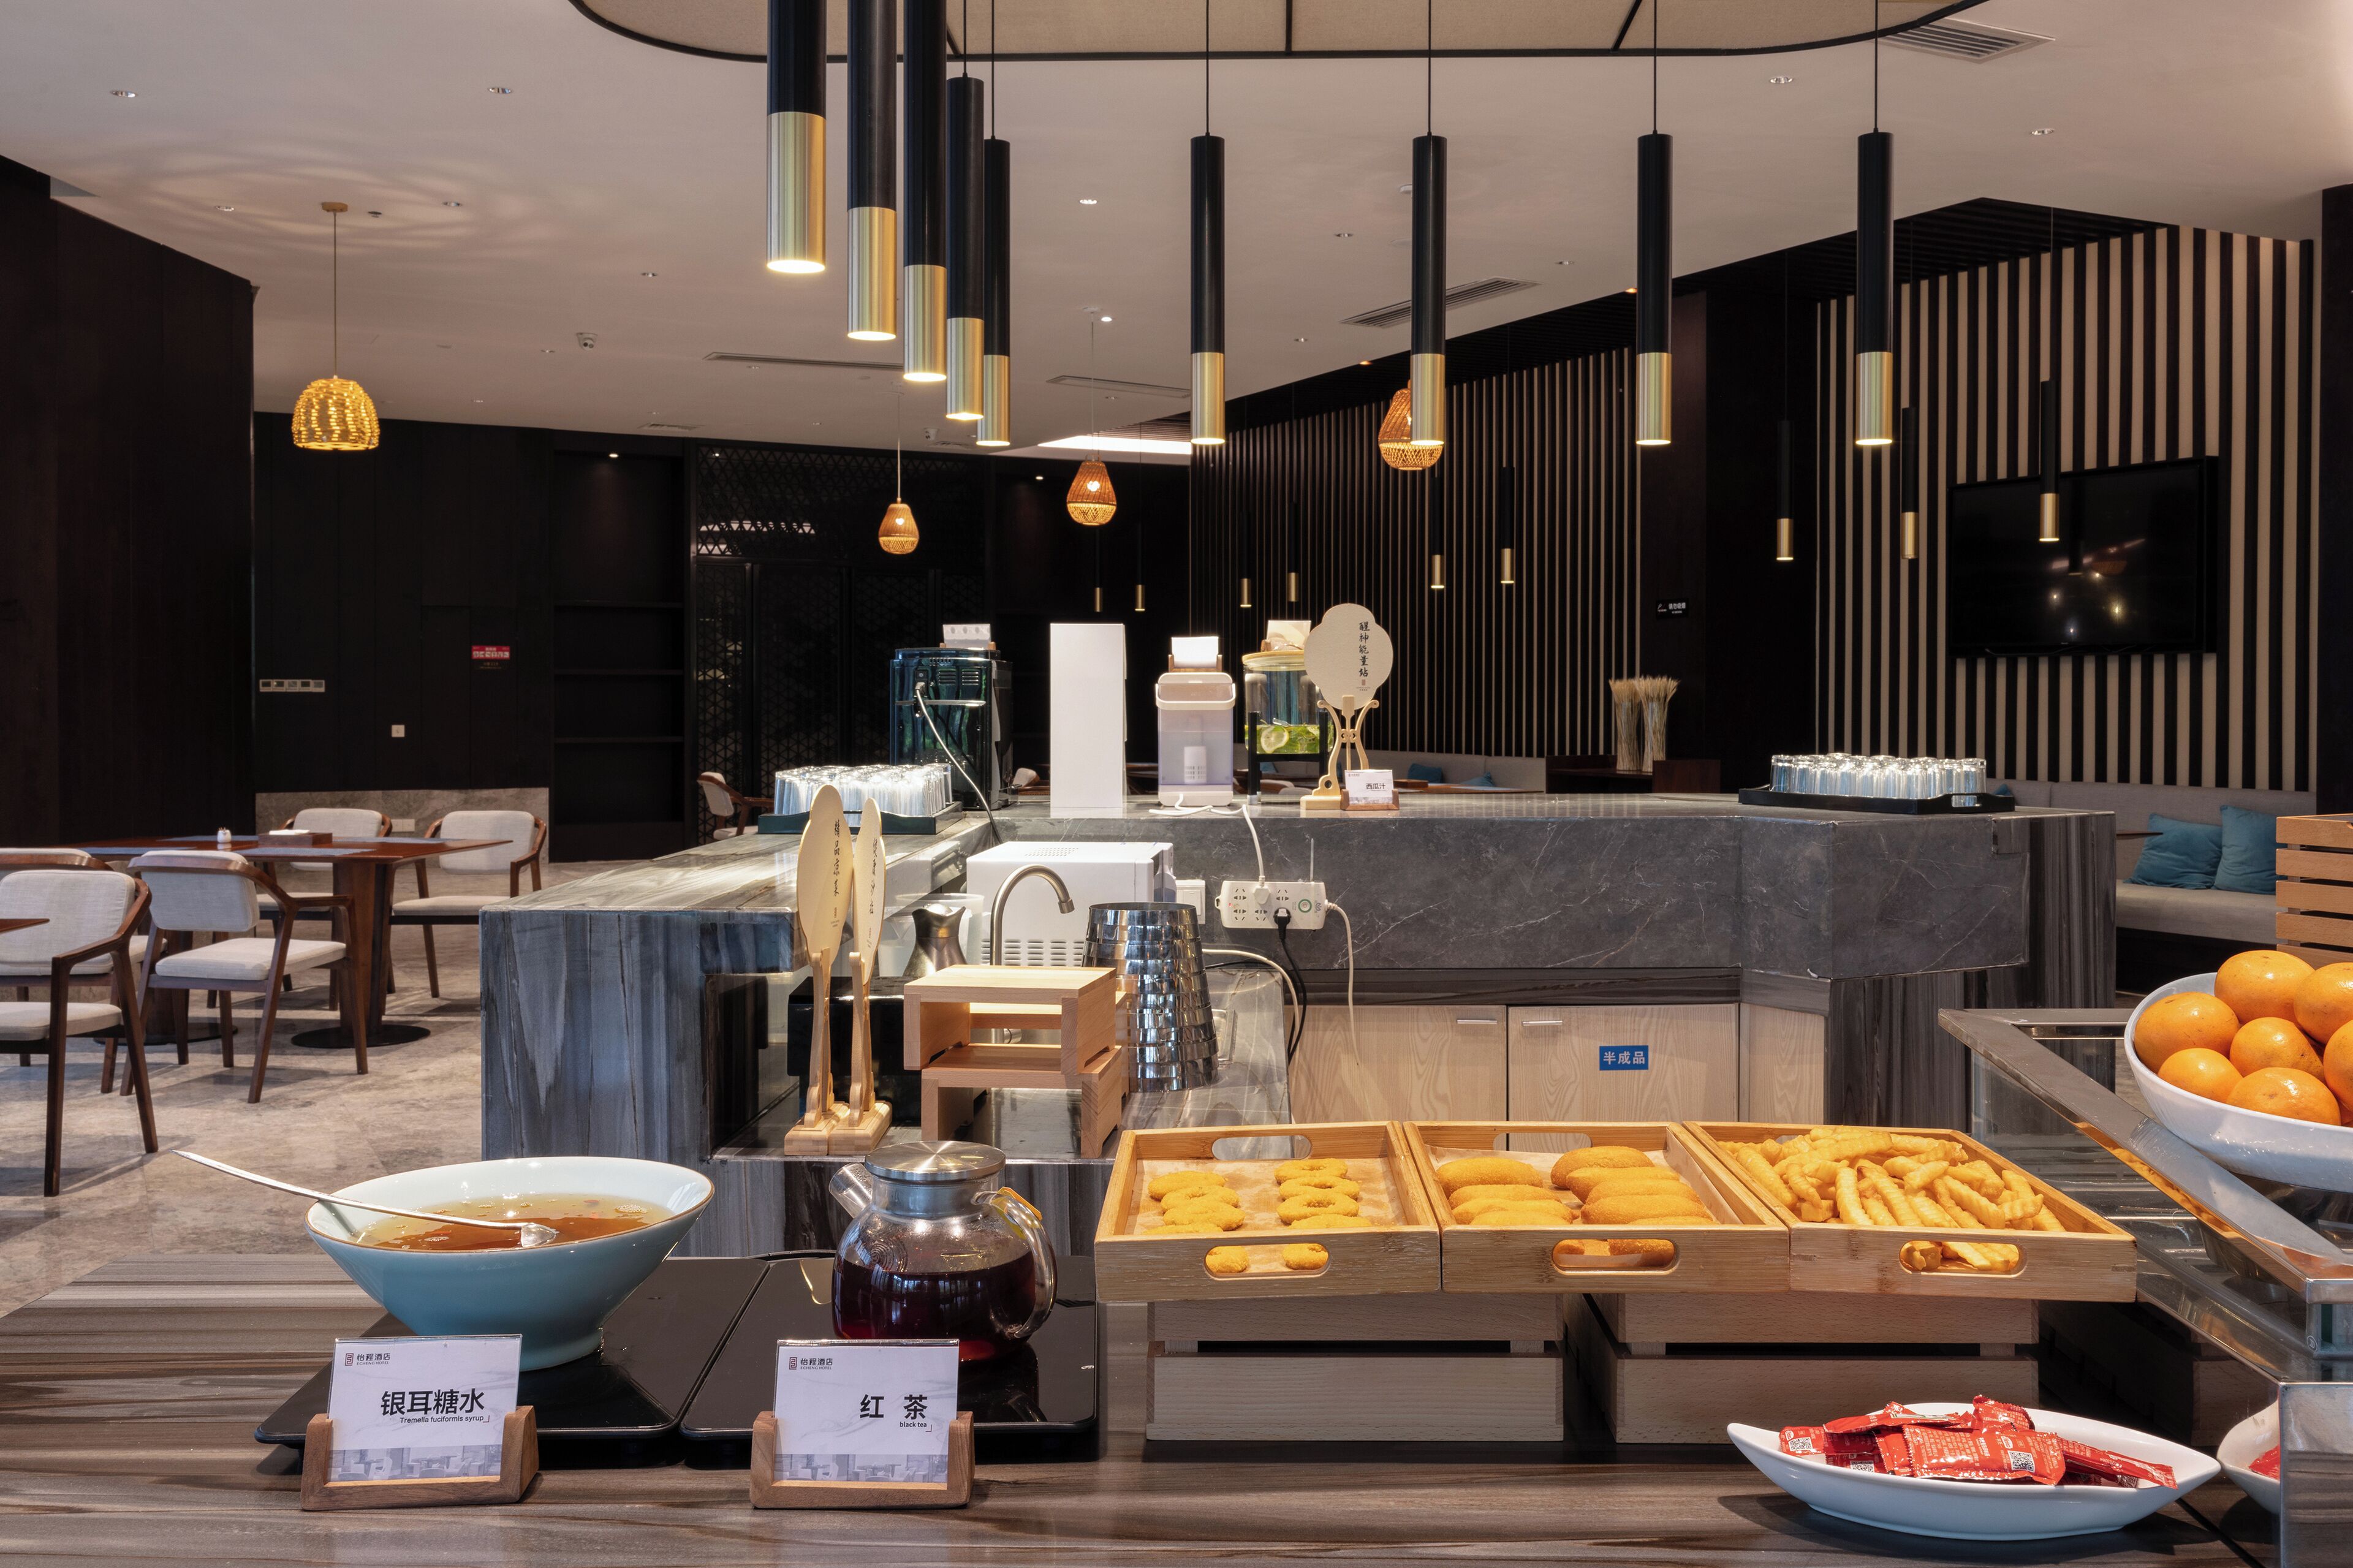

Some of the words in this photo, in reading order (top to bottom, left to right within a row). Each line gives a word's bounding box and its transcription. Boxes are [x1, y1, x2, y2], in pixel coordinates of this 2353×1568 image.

[1358, 621, 1370, 677] 醒神能量站
[1603, 1051, 1645, 1065] 半成品
[357, 1353, 390, 1362] 怡程酒店
[800, 1358, 833, 1366] 怡程酒店
[381, 1388, 485, 1417] 银耳糖水
